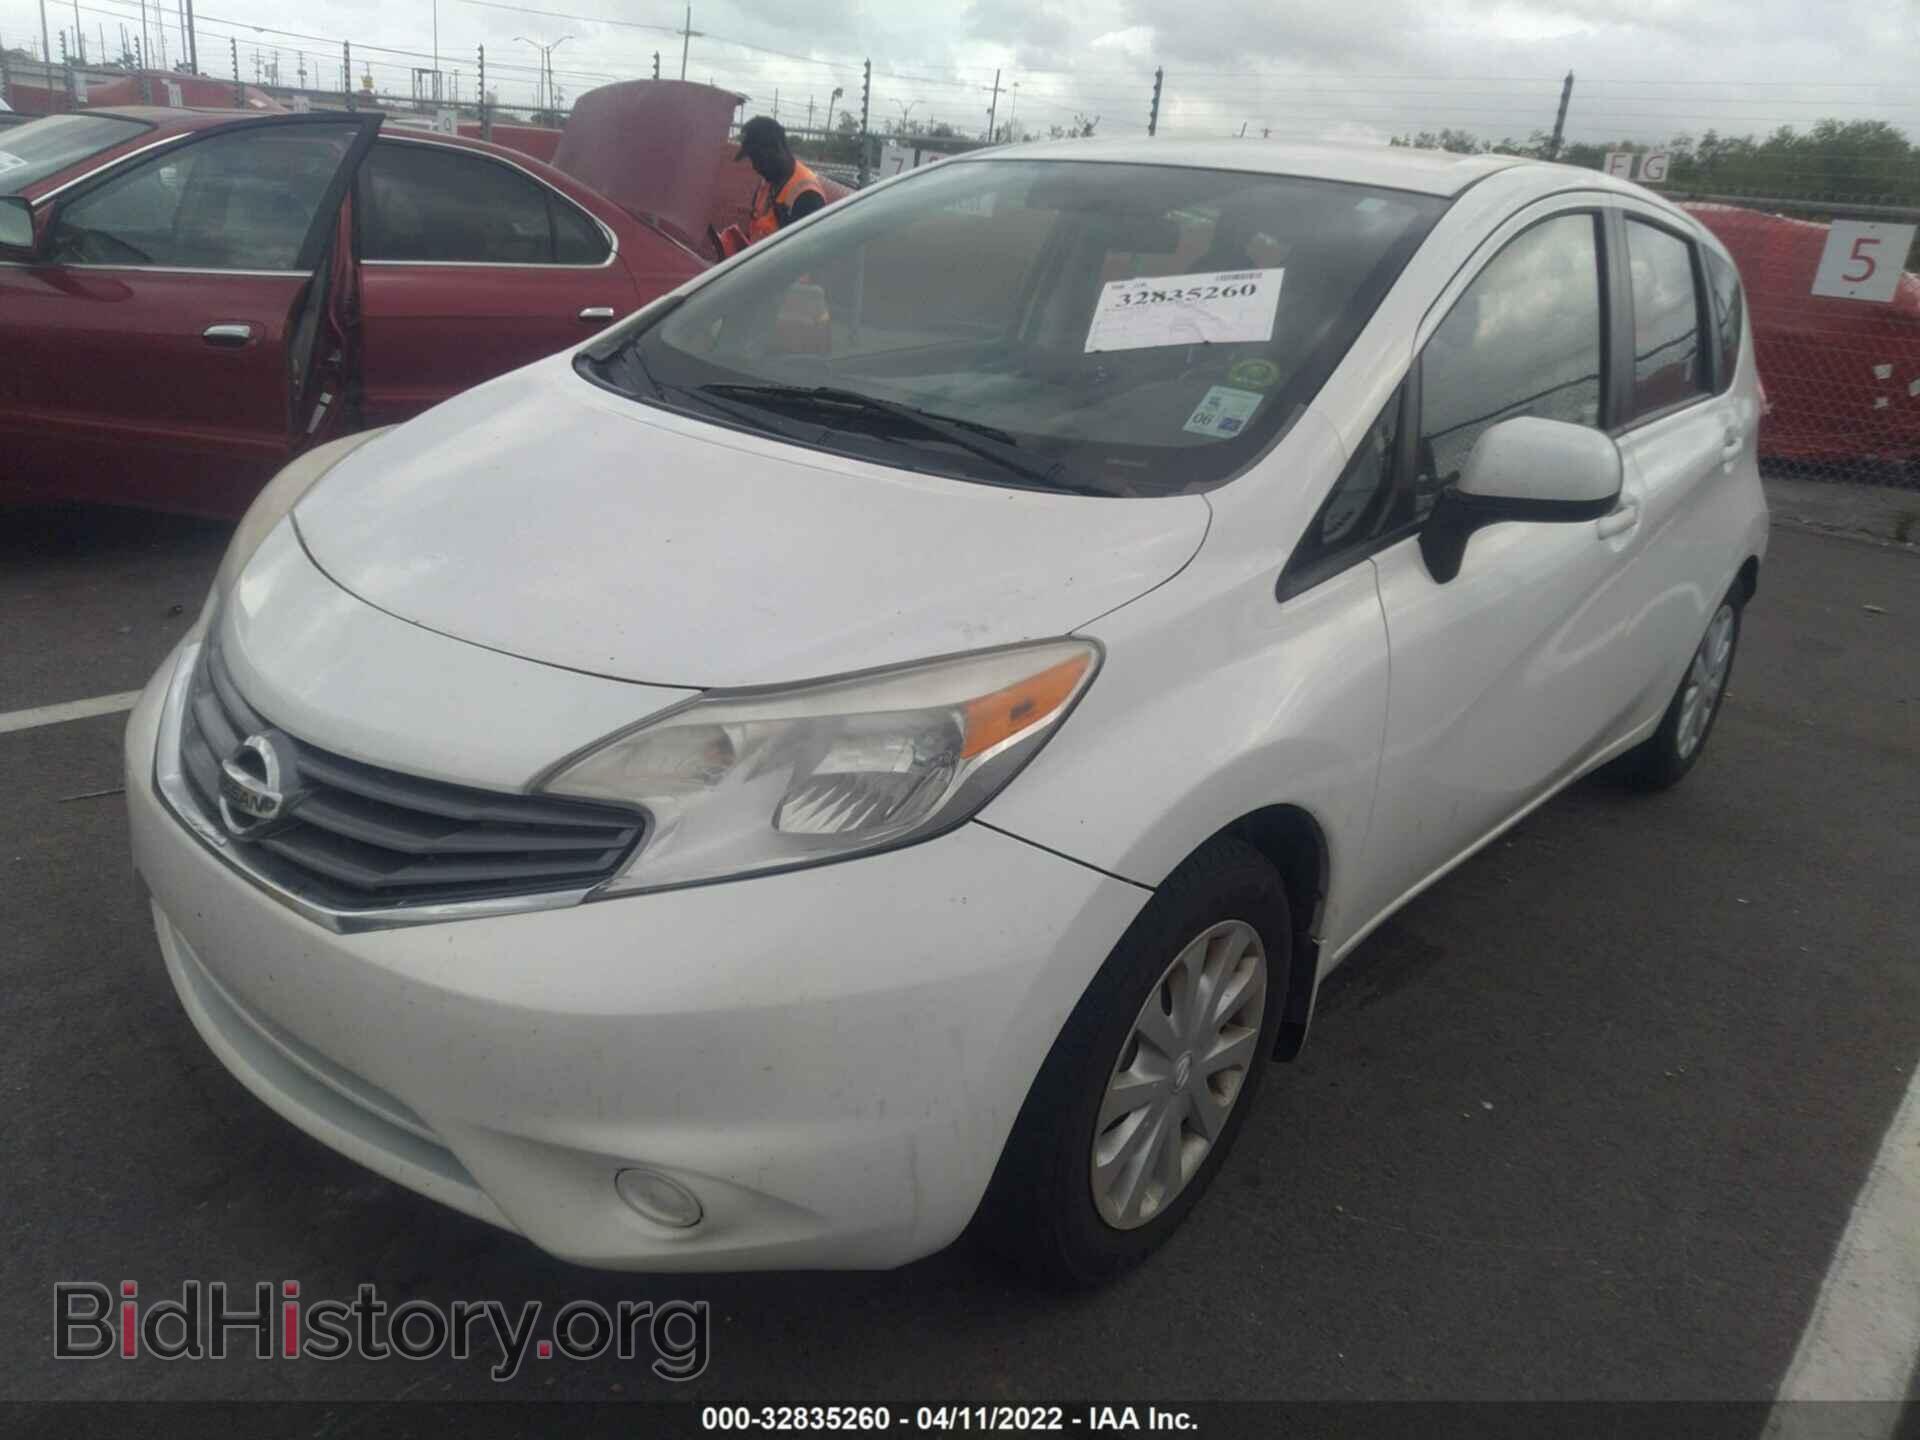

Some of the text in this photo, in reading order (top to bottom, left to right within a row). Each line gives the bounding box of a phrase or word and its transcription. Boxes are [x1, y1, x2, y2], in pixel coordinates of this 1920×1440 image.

[890, 156, 905, 175] 7
[1643, 154, 1665, 180] G
[1841, 237, 1882, 282] 5
[1114, 283, 1257, 308] 32835260
